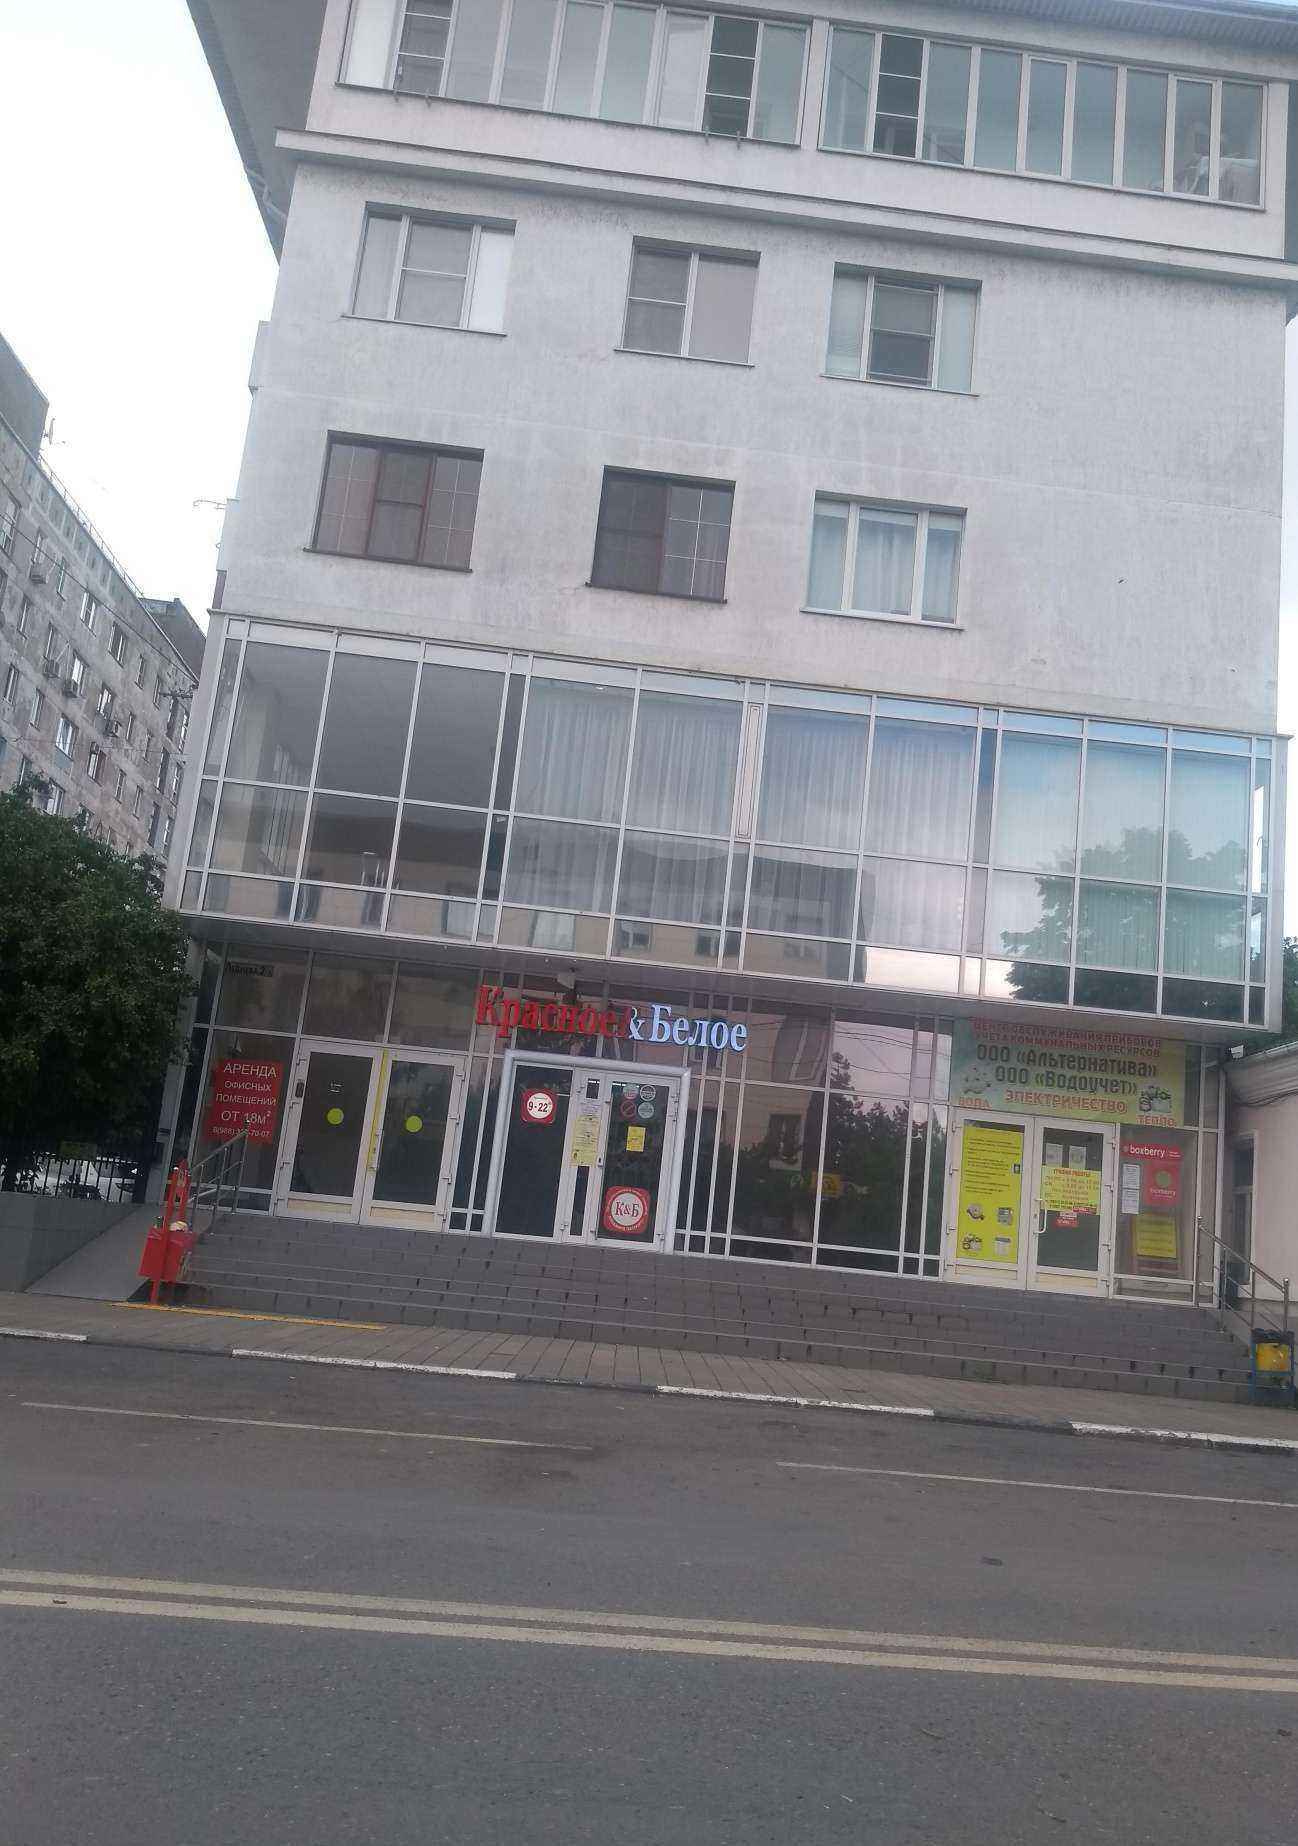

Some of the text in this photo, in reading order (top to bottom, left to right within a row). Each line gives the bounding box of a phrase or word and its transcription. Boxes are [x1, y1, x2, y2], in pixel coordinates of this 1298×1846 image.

[976, 1044, 1158, 1077] ООО «Альтернатива»
[223, 1063, 277, 1078] АРЕНДА
[224, 1080, 272, 1092] ОФИСНЫХ
[995, 1065, 1138, 1097] ООО «Водоучет»
[215, 1093, 278, 1106] ПОМЕЩЕНИЙ
[1005, 1088, 1128, 1114] ЭЛЕКТРИЧЕСТВО
[221, 1110, 241, 1121] ОТ
[1129, 1144, 1166, 1159] boxberry
